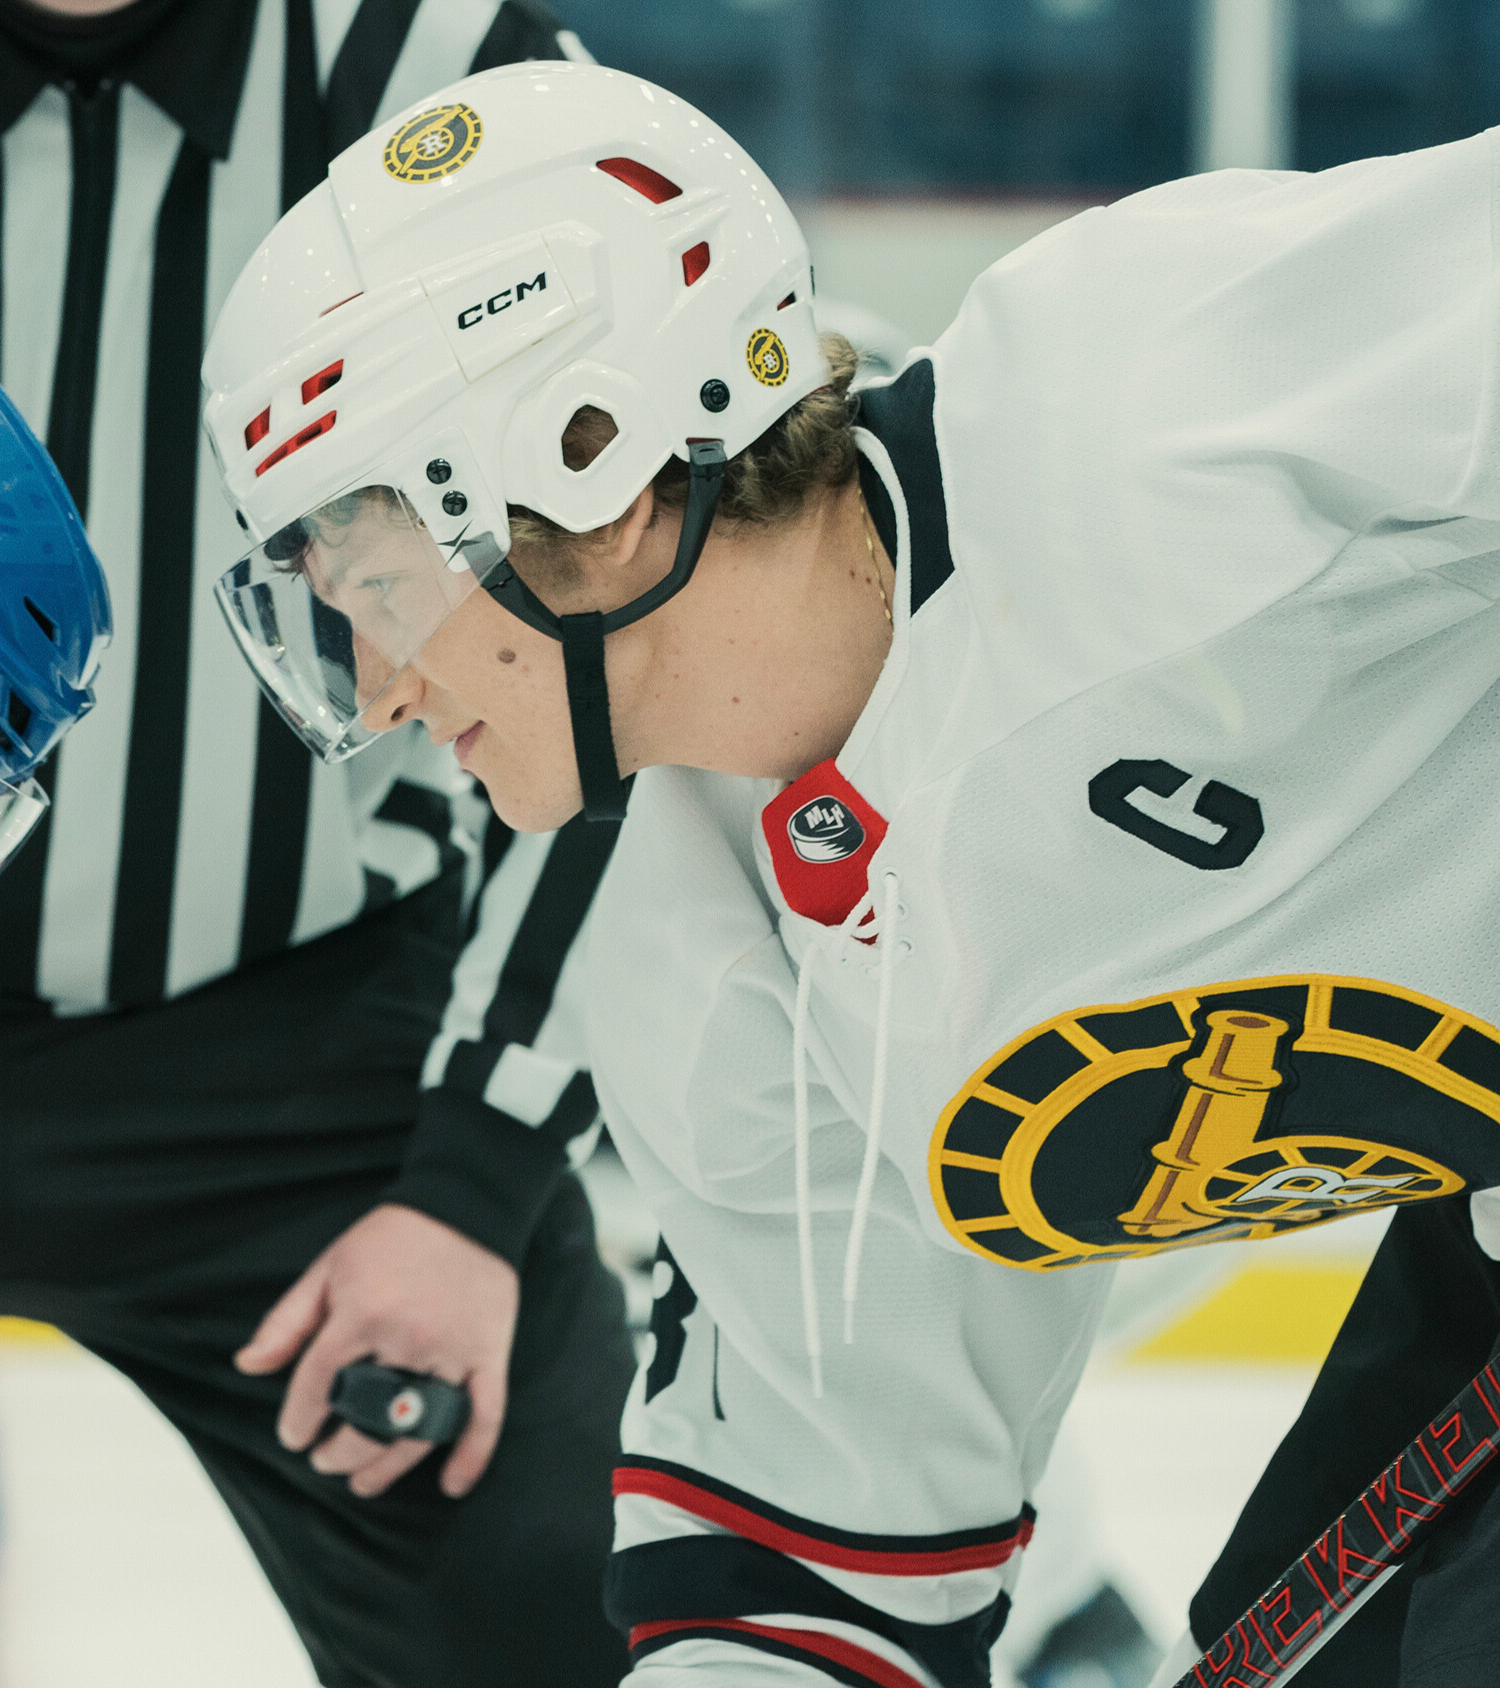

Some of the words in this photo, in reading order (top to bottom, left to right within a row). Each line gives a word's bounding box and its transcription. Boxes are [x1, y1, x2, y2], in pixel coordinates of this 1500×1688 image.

[457, 271, 547, 330] CCM
[804, 803, 846, 833] MLH
[1088, 759, 1265, 871] C
